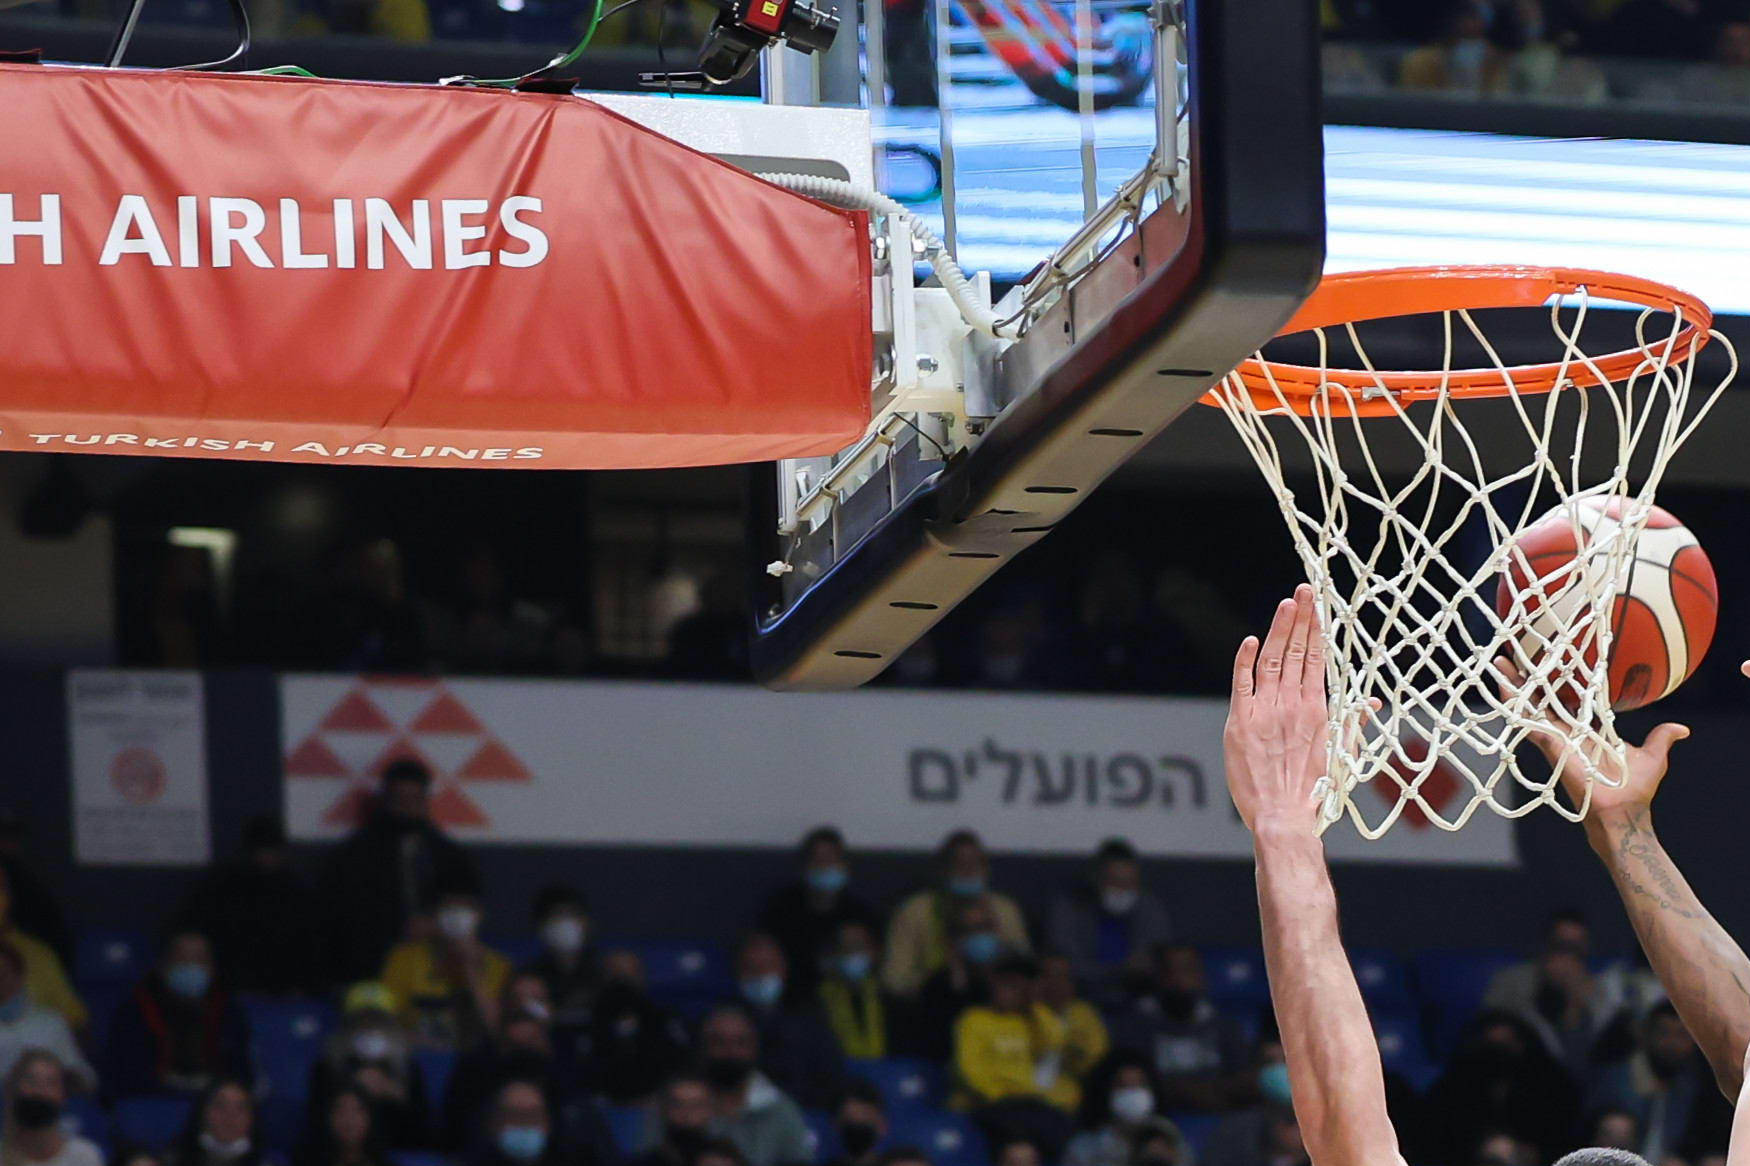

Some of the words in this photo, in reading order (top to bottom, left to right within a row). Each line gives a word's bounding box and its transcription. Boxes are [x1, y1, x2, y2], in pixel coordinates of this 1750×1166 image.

[99, 194, 549, 269] AIRLINES
[29, 433, 275, 453] TURKISH
[290, 441, 543, 460] AIRLINES
[909, 737, 1207, 808] הפועלים
